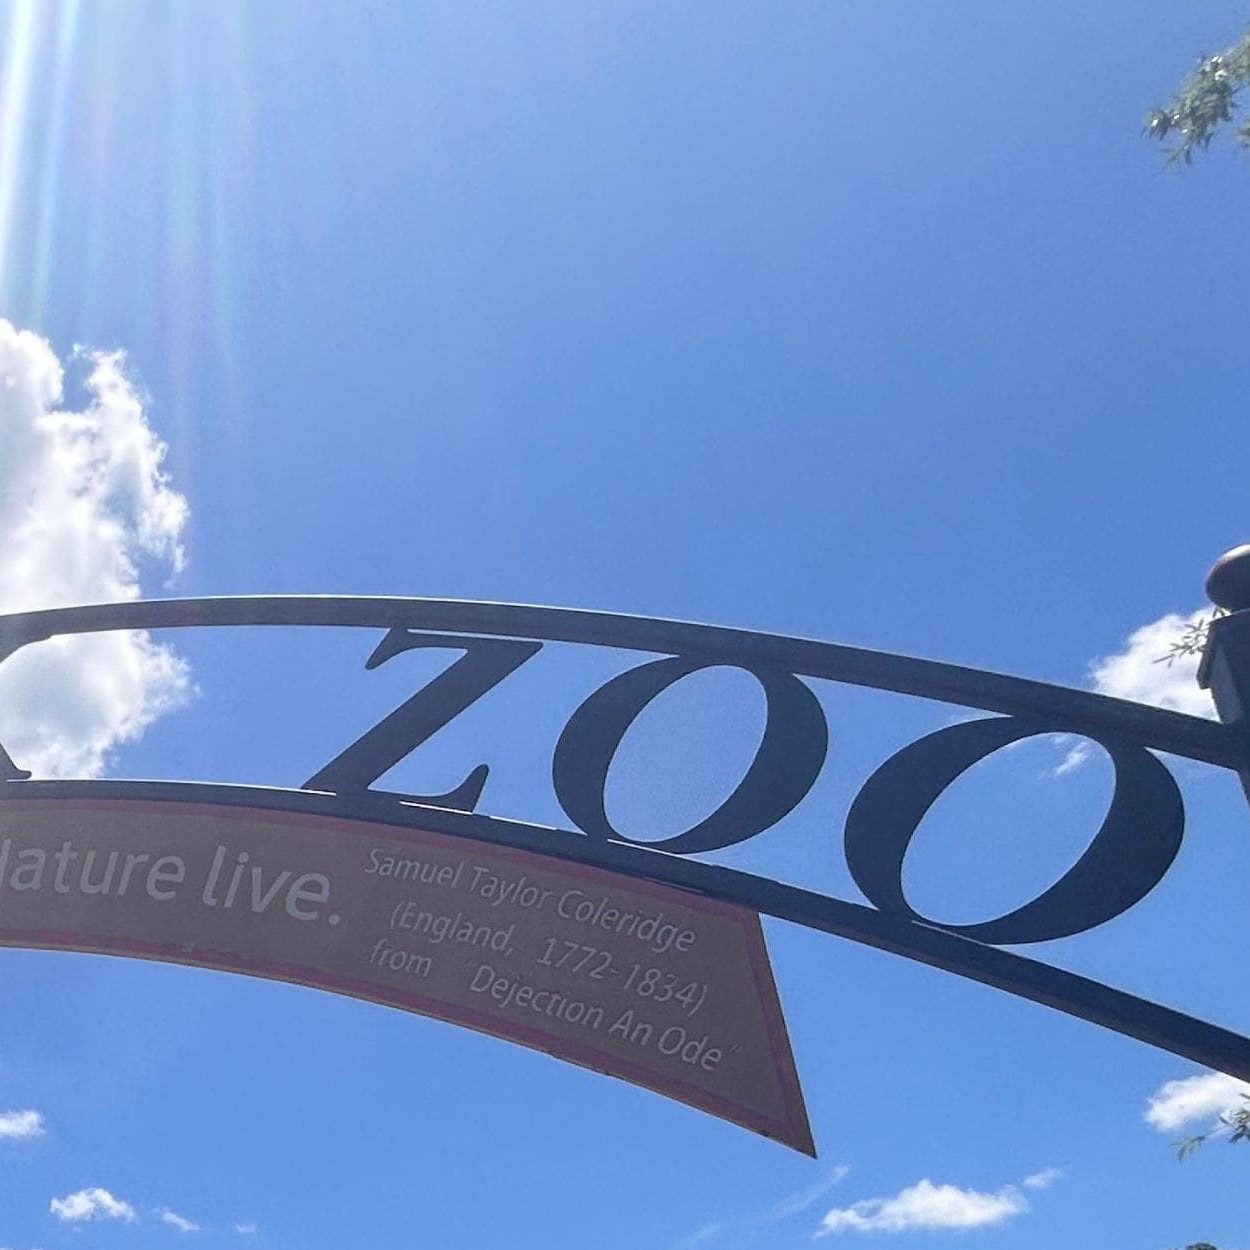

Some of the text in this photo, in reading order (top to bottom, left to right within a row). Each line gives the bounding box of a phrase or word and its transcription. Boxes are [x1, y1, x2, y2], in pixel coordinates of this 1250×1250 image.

[300, 627, 1186, 945] ZOO
[202, 845, 341, 927] live.
[364, 848, 697, 953] Samuel Taylor Coleridge
[390, 900, 516, 957] (England,
[369, 939, 433, 979] from
[610, 1008, 655, 1047] An
